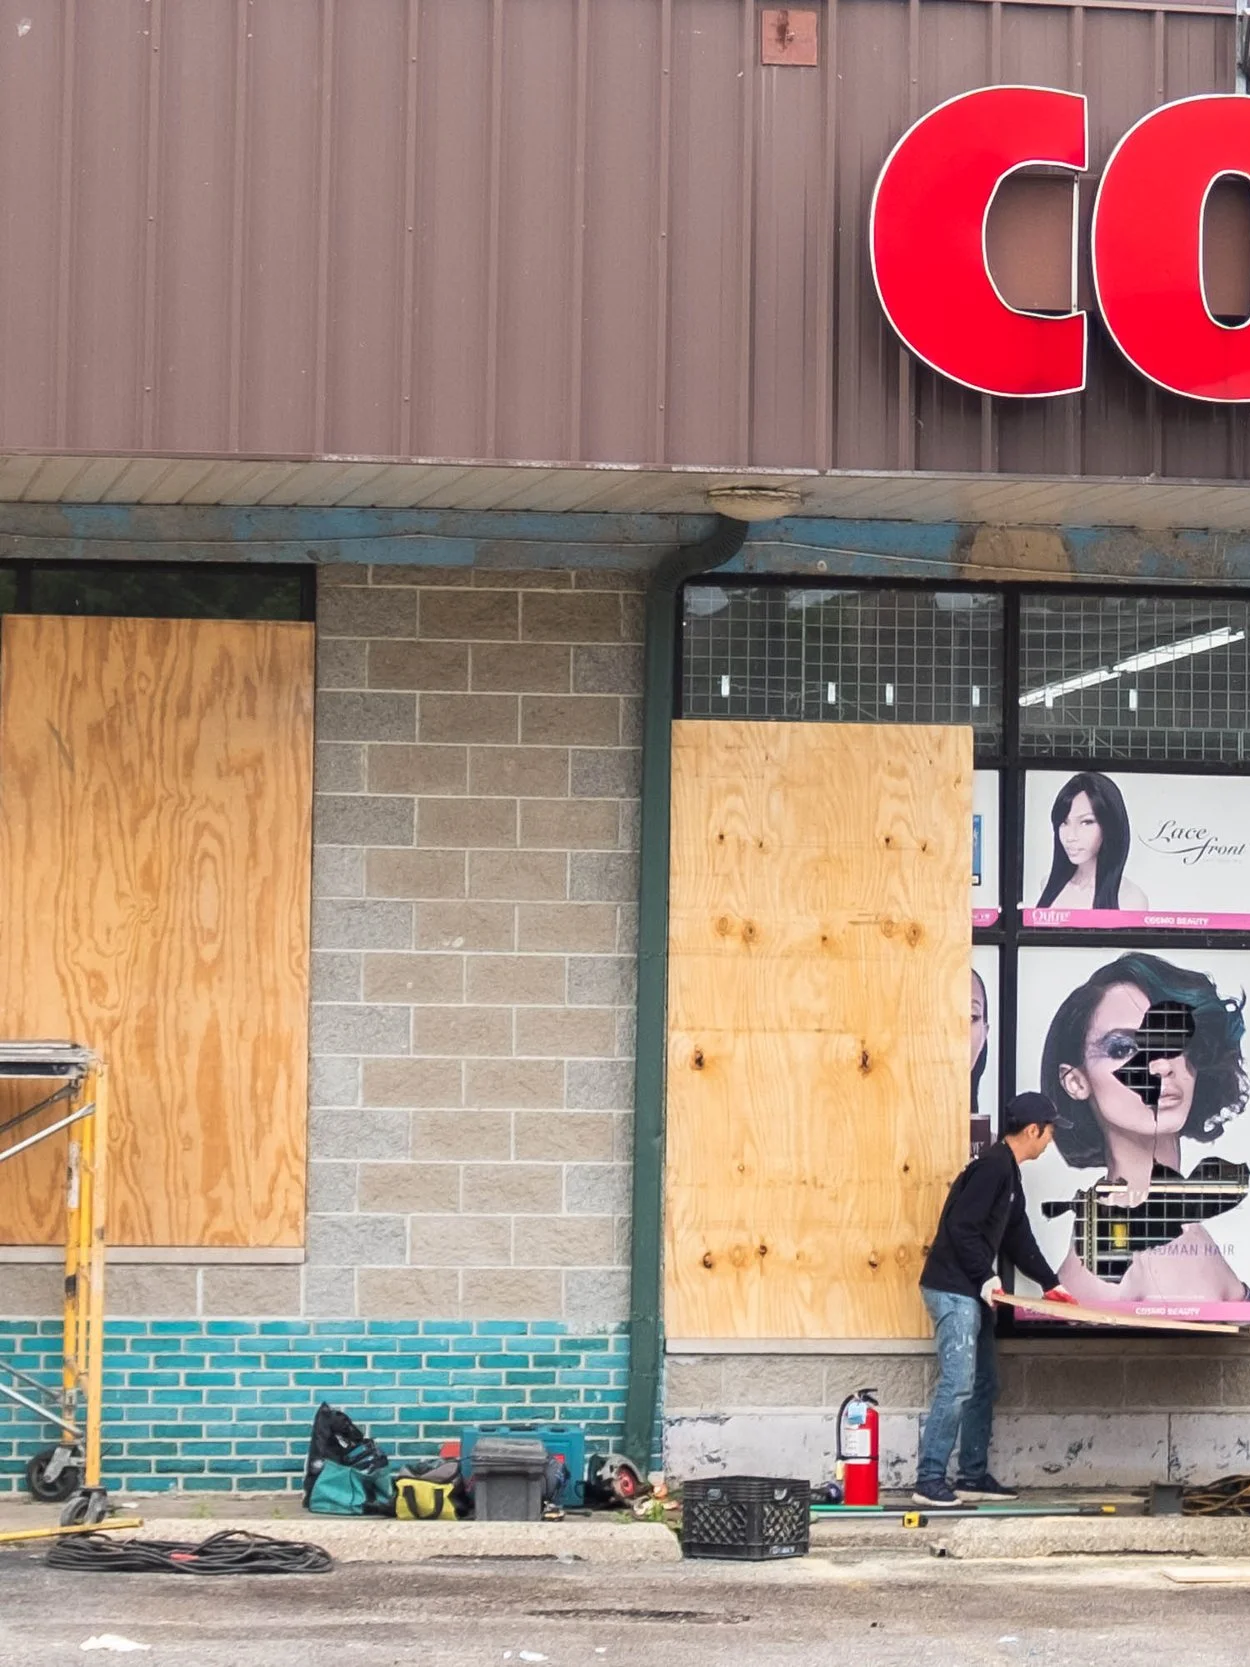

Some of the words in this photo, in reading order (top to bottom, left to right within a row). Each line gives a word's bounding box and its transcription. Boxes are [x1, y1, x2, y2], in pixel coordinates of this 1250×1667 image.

[1149, 819, 1208, 843] Lace
[1168, 836, 1247, 866] front
[1144, 915, 1176, 925] COSMO
[1176, 916, 1209, 926] BEAUTY
[1204, 1243, 1235, 1257] HAIR
[1135, 1307, 1166, 1316] COSMO
[1167, 1307, 1200, 1316] BEAUTY
